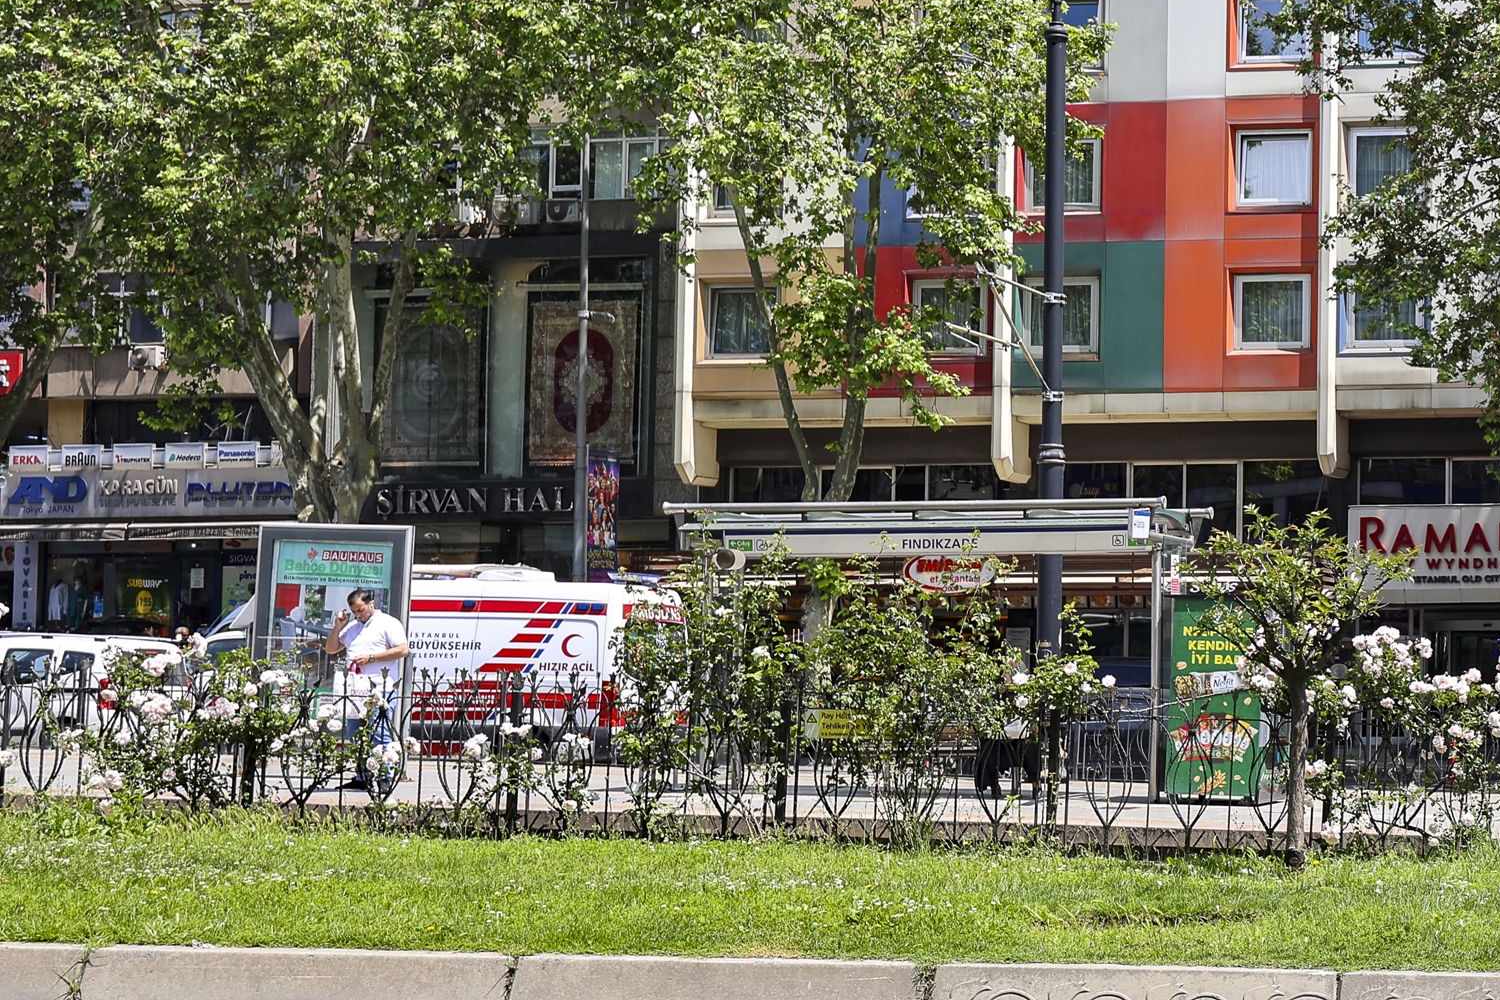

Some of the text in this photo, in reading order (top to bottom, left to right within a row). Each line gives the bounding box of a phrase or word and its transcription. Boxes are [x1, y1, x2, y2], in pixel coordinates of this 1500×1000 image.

[64, 452, 96, 467] BRAUN
[100, 475, 178, 496] KARAGÜN
[186, 481, 294, 496] PLUTON
[376, 486, 488, 520] ŞİRVAN
[22, 506, 44, 514] Tokyo
[902, 538, 979, 549] FINDIKZADE
[229, 554, 256, 563] SIGVA
[322, 551, 384, 563] BAUHAUS
[284, 559, 384, 576] Bahçe Dünyası
[21, 540, 32, 621] IGVARIS
[126, 579, 162, 589] SUBWAY
[1462, 575, 1482, 583] OLD
[410, 631, 460, 639] İSTANBUL
[409, 639, 482, 652] BÜYÜKŞEHİR
[1191, 651, 1210, 665] İYİ
[538, 661, 595, 673] HIZIR ACİL
[1213, 674, 1234, 688] Nesfit
[821, 722, 850, 730] Tehlikeli
